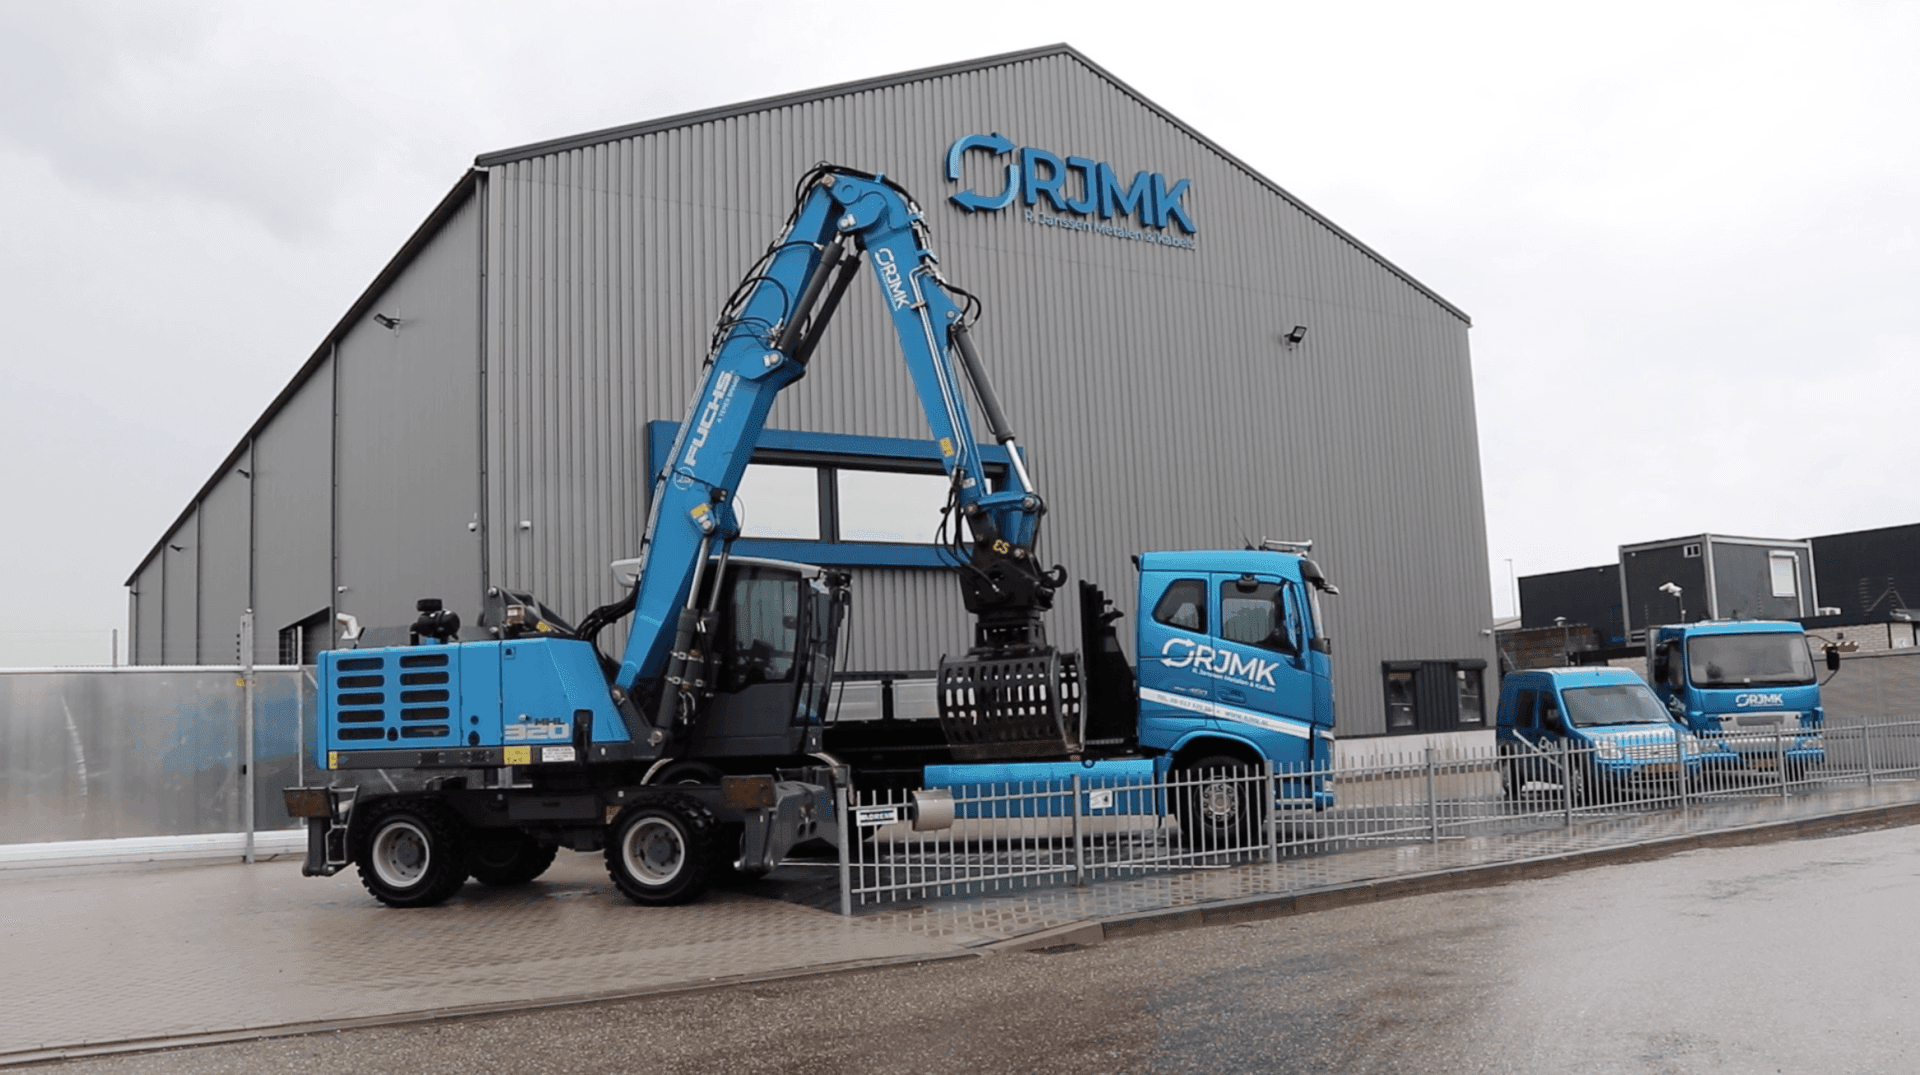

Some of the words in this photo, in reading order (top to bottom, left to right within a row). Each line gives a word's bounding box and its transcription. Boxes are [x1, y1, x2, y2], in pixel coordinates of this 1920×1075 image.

[1020, 147, 1196, 233] RJMK
[1024, 209, 1035, 223] R.
[1039, 212, 1092, 231] Janssen
[1093, 222, 1144, 241] Metalen
[1156, 233, 1196, 251] Kabels
[882, 262, 910, 309] RJMK
[684, 370, 733, 467] FUCHS
[1193, 644, 1280, 686] RJMK
[1748, 694, 1784, 704] RJMK
[505, 723, 570, 740] 320
